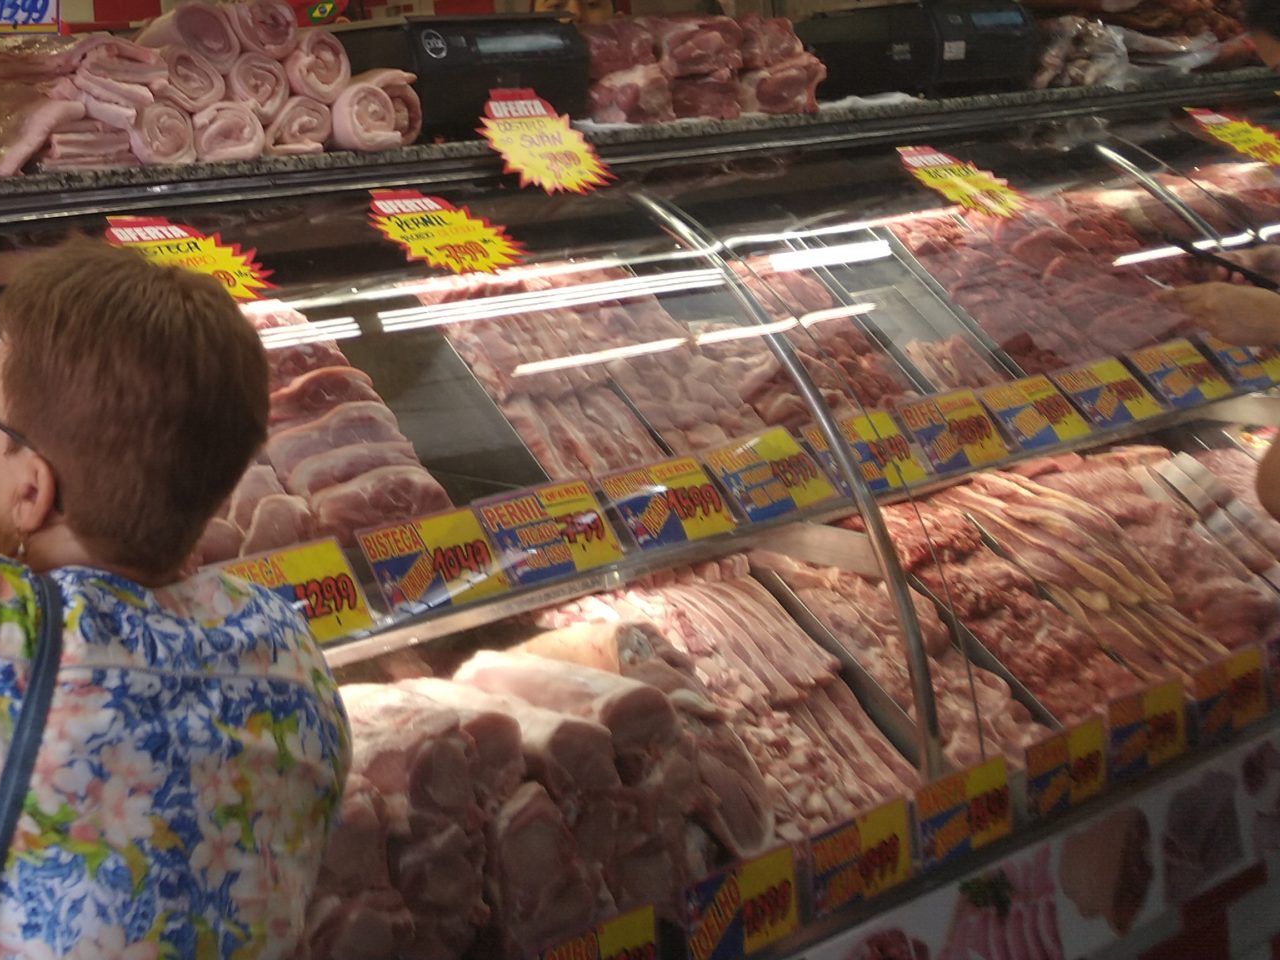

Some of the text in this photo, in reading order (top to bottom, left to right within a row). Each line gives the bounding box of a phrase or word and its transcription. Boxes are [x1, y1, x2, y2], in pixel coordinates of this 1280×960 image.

[488, 99, 548, 118] OFERTA
[373, 197, 444, 214] OFERTA
[110, 224, 190, 241] OFERTA
[901, 399, 944, 429] BIFE
[481, 495, 548, 532] PERNIL
[362, 524, 424, 561] BISTECA
